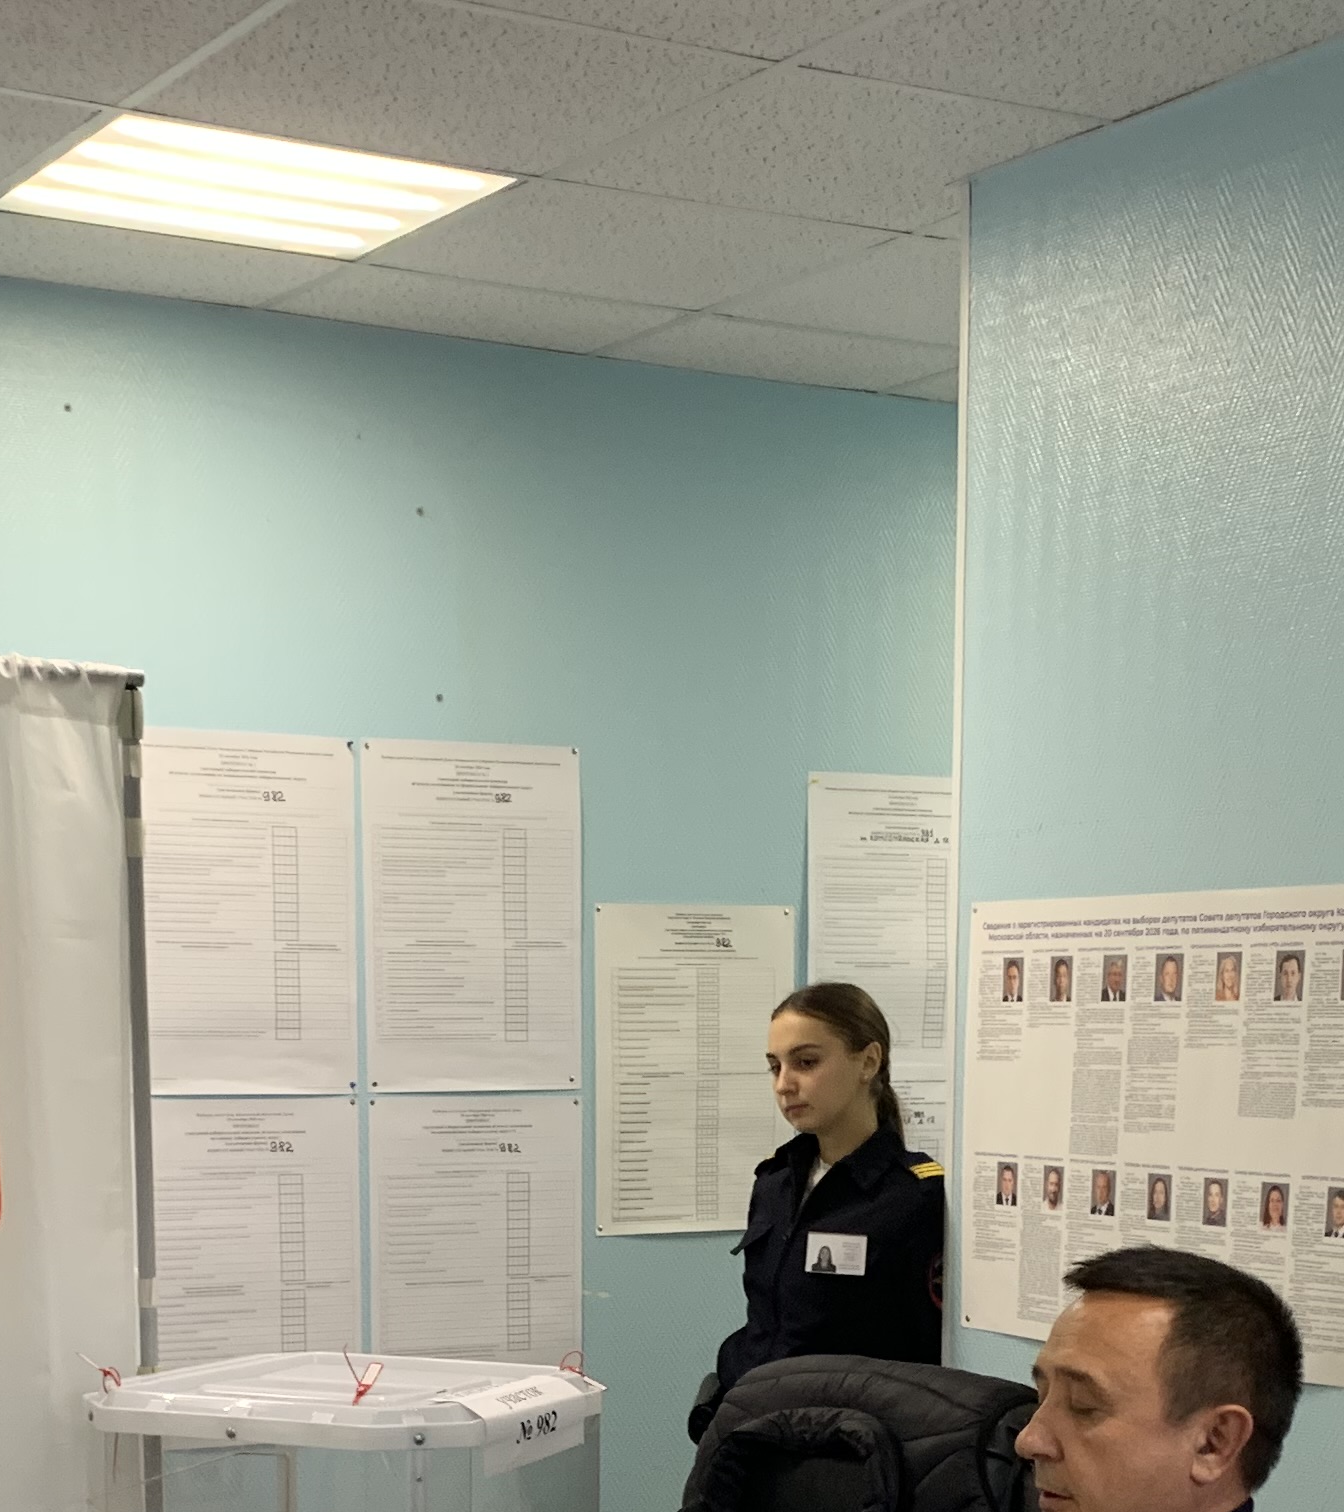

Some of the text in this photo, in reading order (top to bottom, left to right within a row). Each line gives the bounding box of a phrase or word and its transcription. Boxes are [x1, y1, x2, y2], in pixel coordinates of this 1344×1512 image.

[983, 922, 1011, 930] Сведения
[1018, 919, 1082, 929] зарегистрированных
[1083, 918, 1121, 927] кандидатах
[1132, 915, 1160, 925] выборах
[1162, 913, 1197, 924] депутатов
[1199, 913, 1223, 922] Совета
[1225, 912, 1261, 921] депутатов
[1263, 910, 1306, 919] Городского
[1308, 909, 1334, 918] округа
[988, 933, 1023, 941] Московской
[1025, 932, 1049, 941] области,
[1051, 931, 1092, 939] назначенных
[1104, 929, 1112, 937] 20
[1113, 928, 1144, 938] сентября
[1146, 928, 1161, 936] 2026
[1191, 925, 1251, 934] пятимандатному
[1253, 923, 1316, 932] избирательному
[1319, 922, 1344, 931] округу
